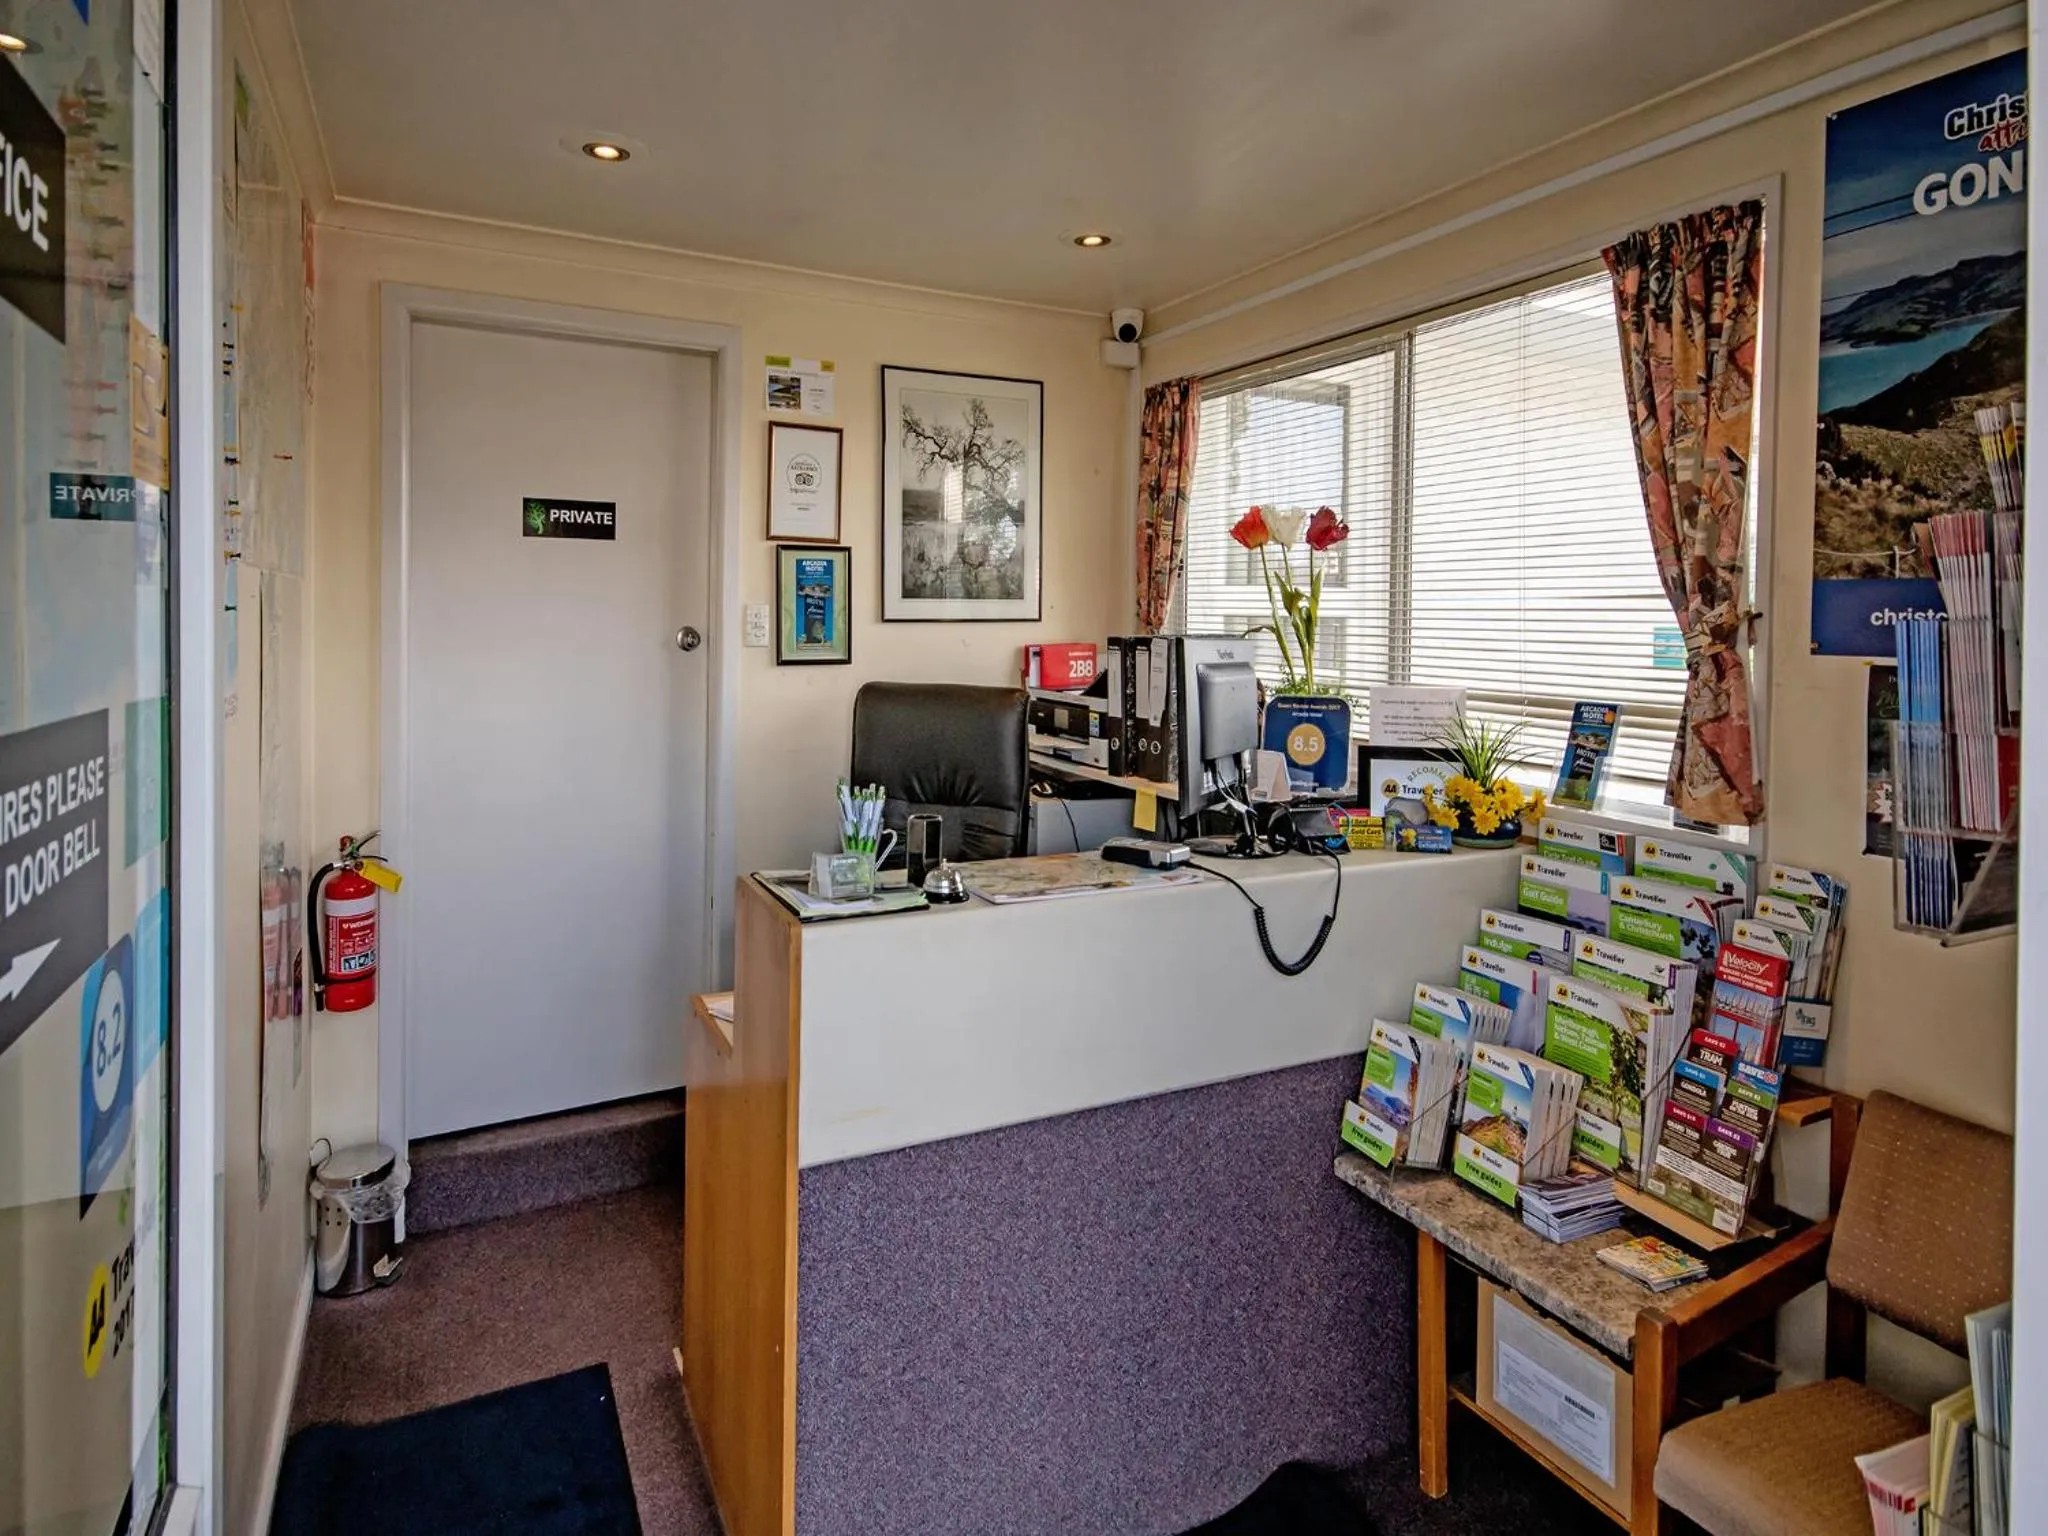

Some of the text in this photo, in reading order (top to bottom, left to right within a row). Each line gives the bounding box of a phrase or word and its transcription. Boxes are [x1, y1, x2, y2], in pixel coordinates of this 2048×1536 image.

[1944, 92, 2029, 140] Chris
[1913, 149, 2024, 216] GON
[549, 508, 613, 525] PRIVATE
[1068, 659, 1094, 678] 2B8
[1293, 736, 1319, 752] 8.5
[46, 756, 104, 821] PLEASE
[1557, 829, 1584, 840] Traveller
[1659, 848, 1692, 861] Traveller
[5, 818, 100, 918] DOOR BELL
[1537, 864, 1566, 877] Traveller
[1635, 890, 1666, 904] Traveller
[1497, 919, 1524, 933] Traveller
[1595, 948, 1625, 964] Traveller
[1480, 958, 1505, 973] Traveller
[1570, 991, 1599, 1009] Traveller
[96, 1002, 121, 1078] 8.2
[1487, 1055, 1511, 1071] Traveller
[1700, 1049, 1724, 1066] TRAM
[1480, 1168, 1503, 1189] guides
